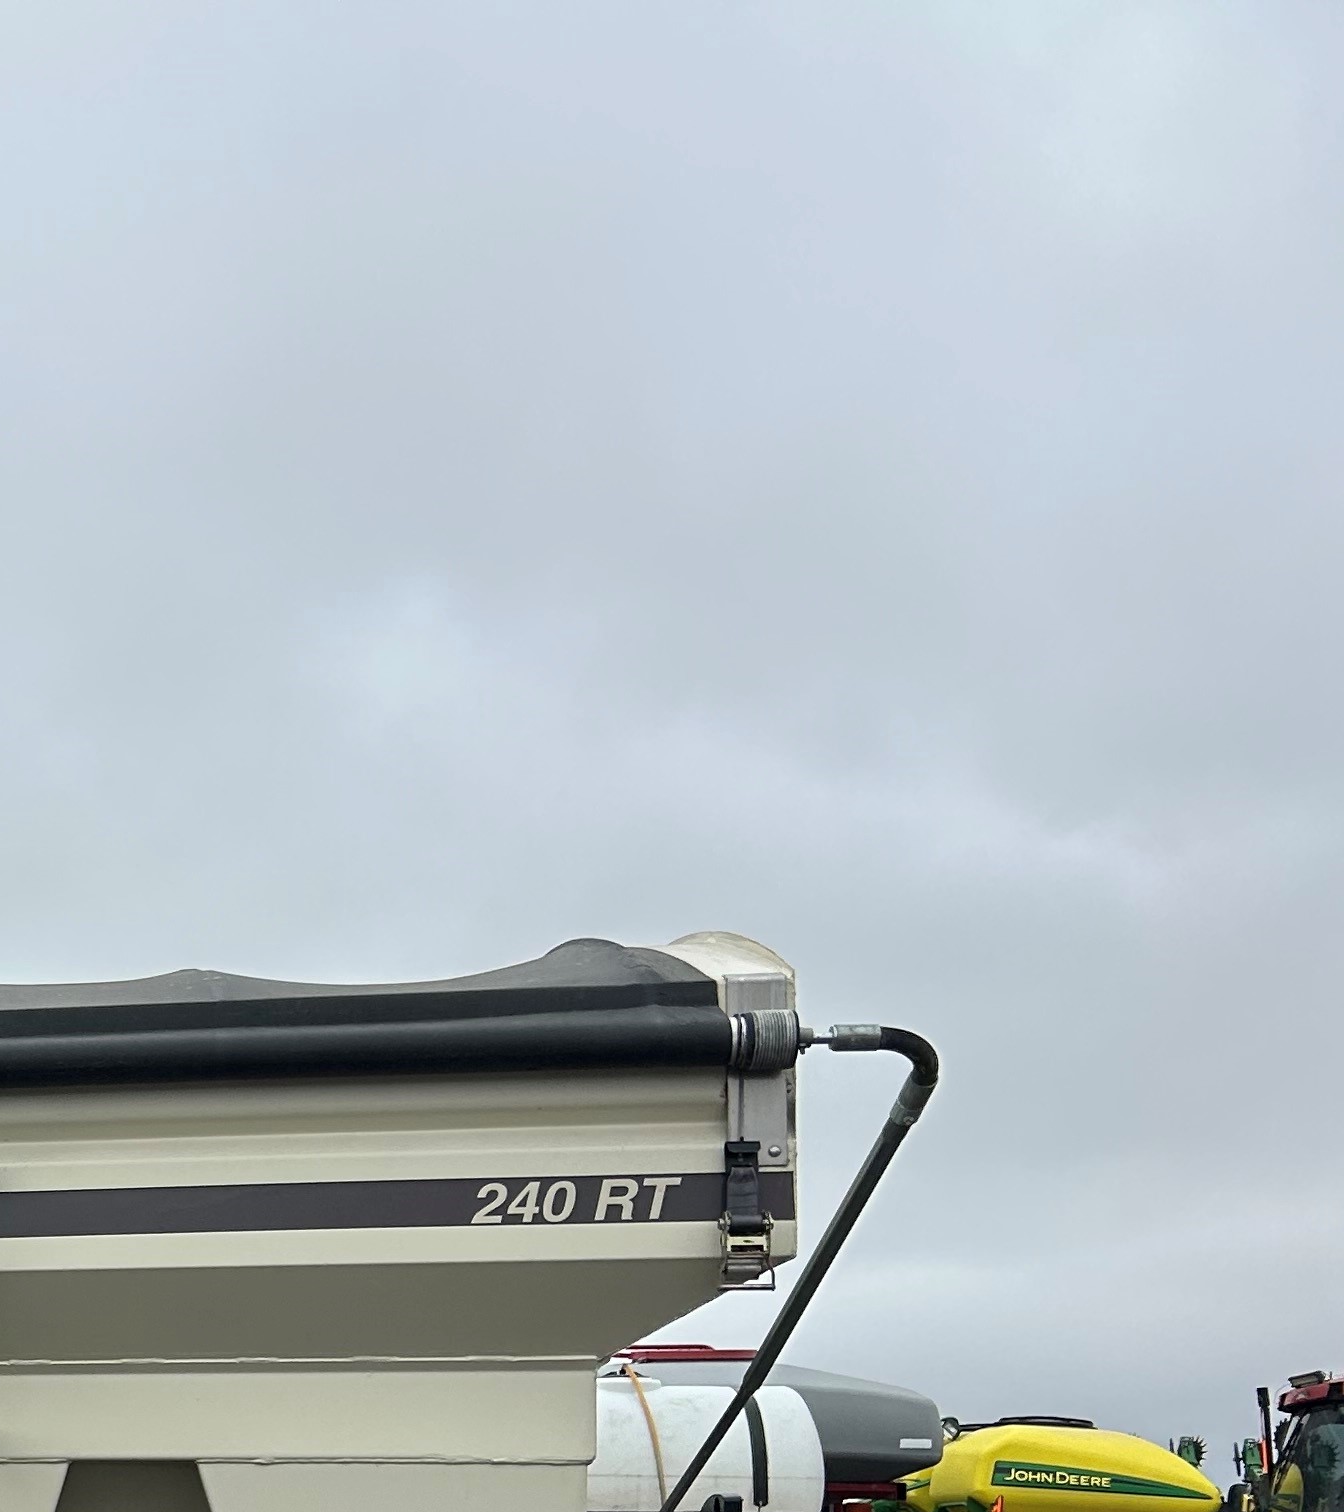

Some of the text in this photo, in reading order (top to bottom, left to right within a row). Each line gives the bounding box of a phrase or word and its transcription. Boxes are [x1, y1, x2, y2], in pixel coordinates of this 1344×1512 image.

[470, 1177, 683, 1225] 240 RT
[1003, 1468, 1112, 1488] JOHN DEERE
